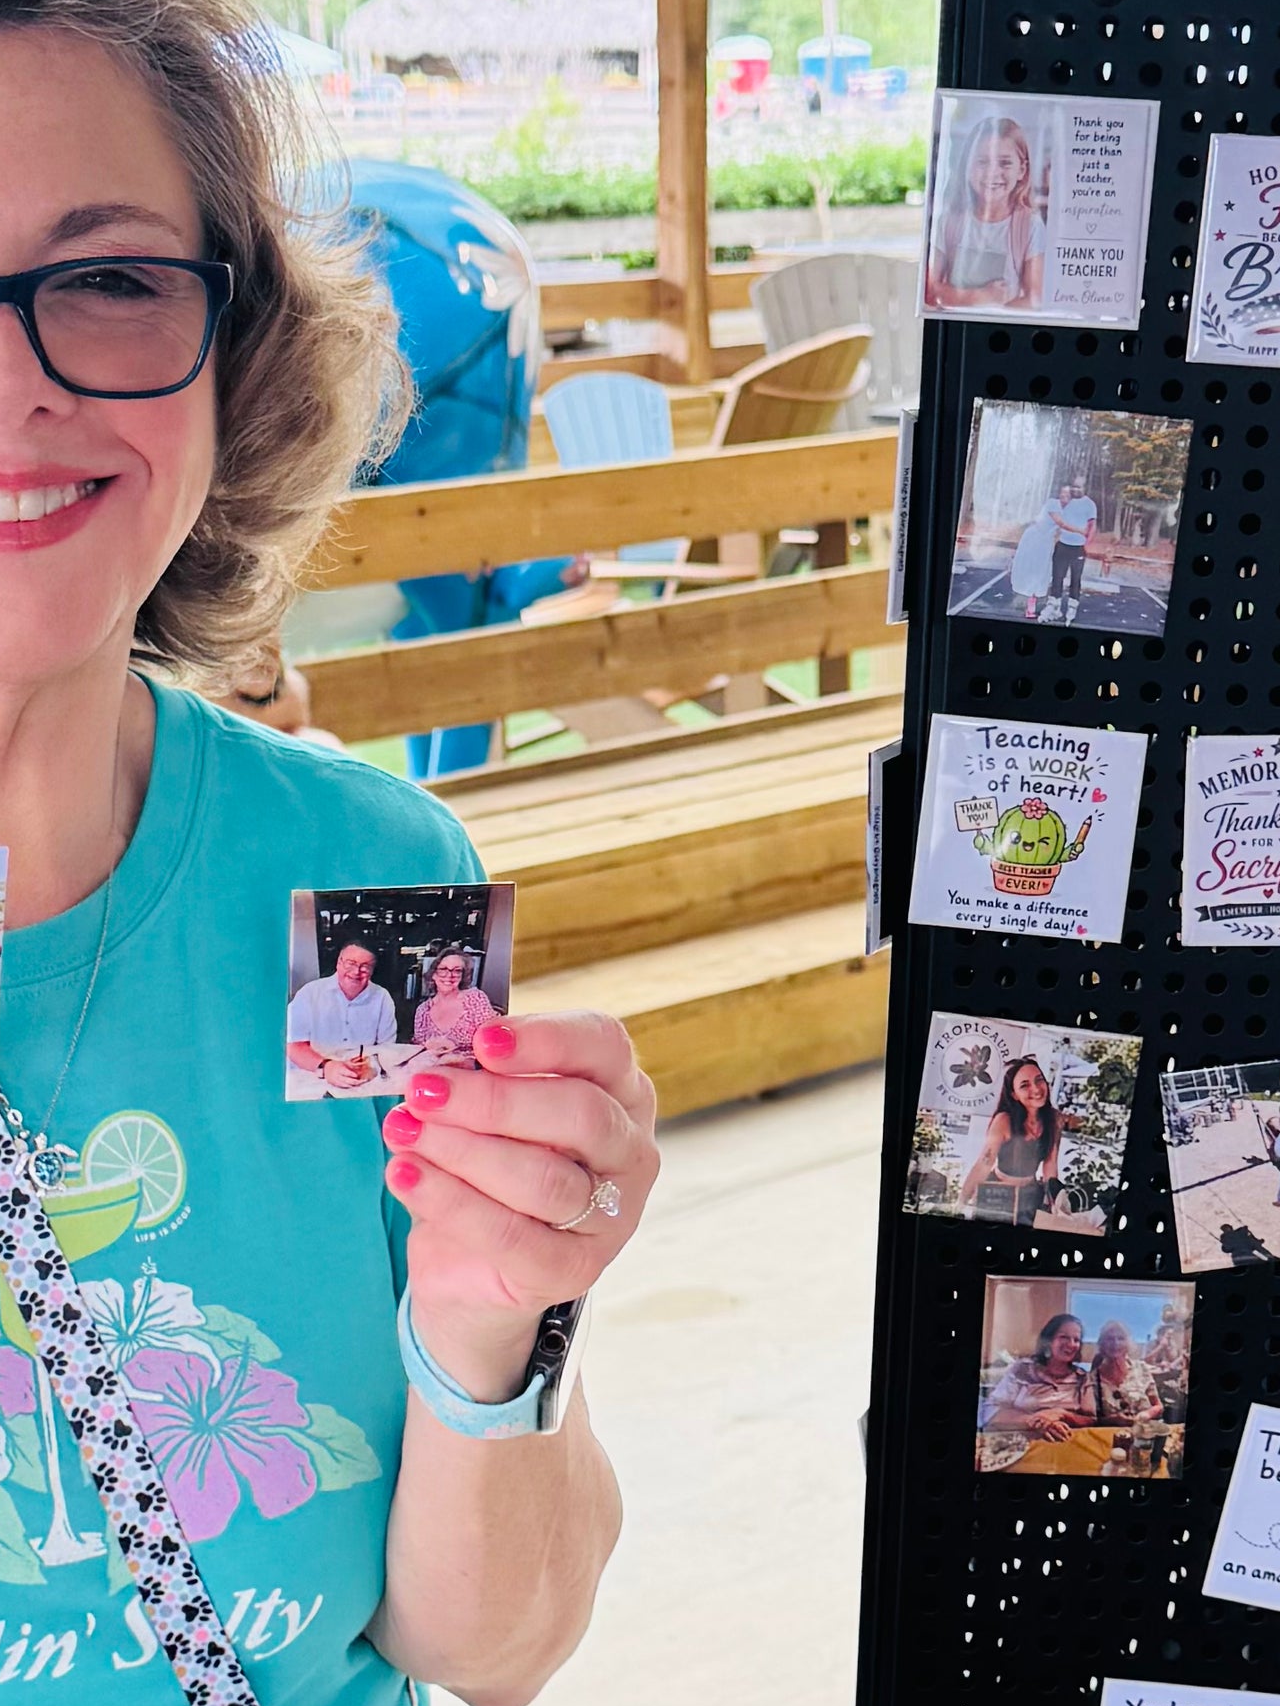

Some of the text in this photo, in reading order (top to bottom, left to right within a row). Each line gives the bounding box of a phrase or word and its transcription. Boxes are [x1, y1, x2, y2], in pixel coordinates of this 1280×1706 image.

[1073, 117, 1124, 131] Thank you
[1075, 130, 1121, 145] for being
[1072, 146, 1122, 156] more than
[1081, 162, 1100, 172] just
[1056, 247, 1124, 261] THANK YOU
[1061, 264, 1117, 277] TEACHER!
[1248, 346, 1277, 356] HAPPY
[976, 726, 1090, 761] Teaching
[979, 755, 1093, 782] is a WORK
[988, 775, 1087, 803] of heart!
[960, 802, 993, 813] THANK
[1252, 839, 1273, 847] FOR
[1006, 878, 1040, 890] EVER!
[948, 889, 970, 905] You
[977, 896, 1008, 910] make
[1027, 901, 1089, 918] difference
[1216, 906, 1262, 917] REMEMBER
[956, 913, 1075, 937] every single day!
[935, 1022, 1010, 1064] TROPICAUR
[1223, 1561, 1246, 1575] an
[113, 1584, 323, 1672] Slty
